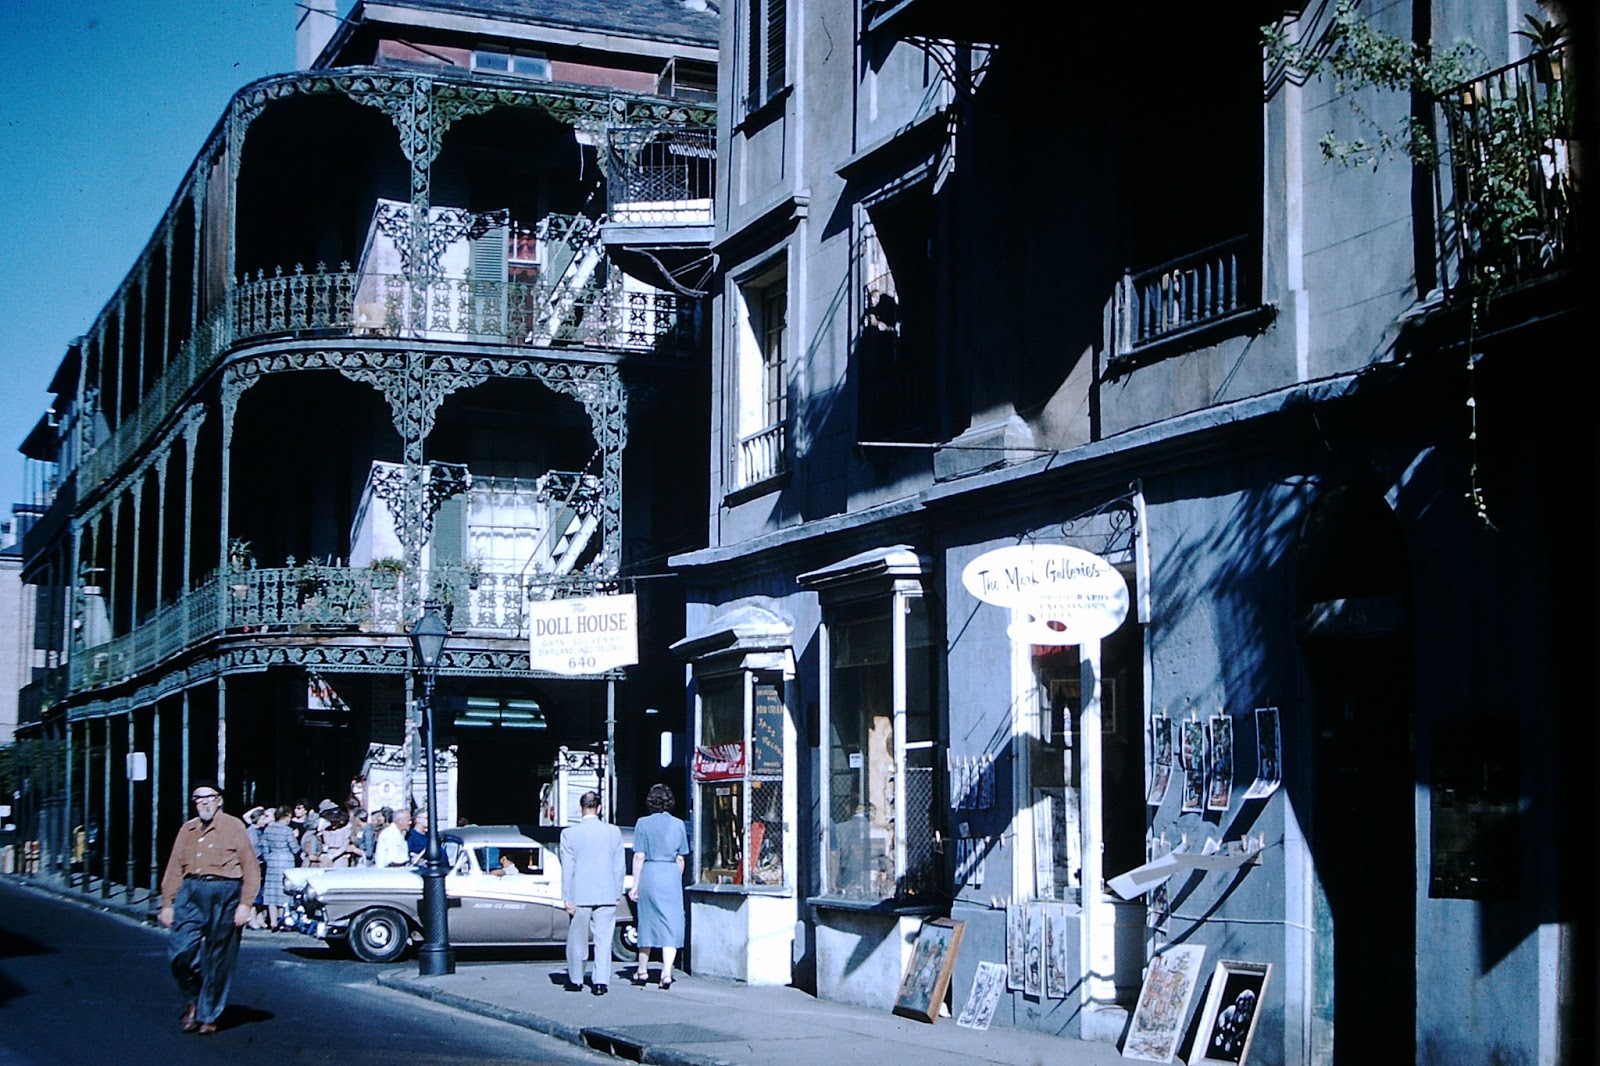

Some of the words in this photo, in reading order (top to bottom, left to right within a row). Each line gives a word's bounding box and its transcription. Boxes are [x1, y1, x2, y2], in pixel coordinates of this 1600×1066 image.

[977, 569, 999, 595] The
[1045, 558, 1104, 583] Galleries
[571, 603, 587, 613] The
[536, 617, 573, 637] DOLL
[577, 613, 628, 634] HOUSE
[568, 656, 596, 669] 640
[758, 718, 776, 737] JAZZ
